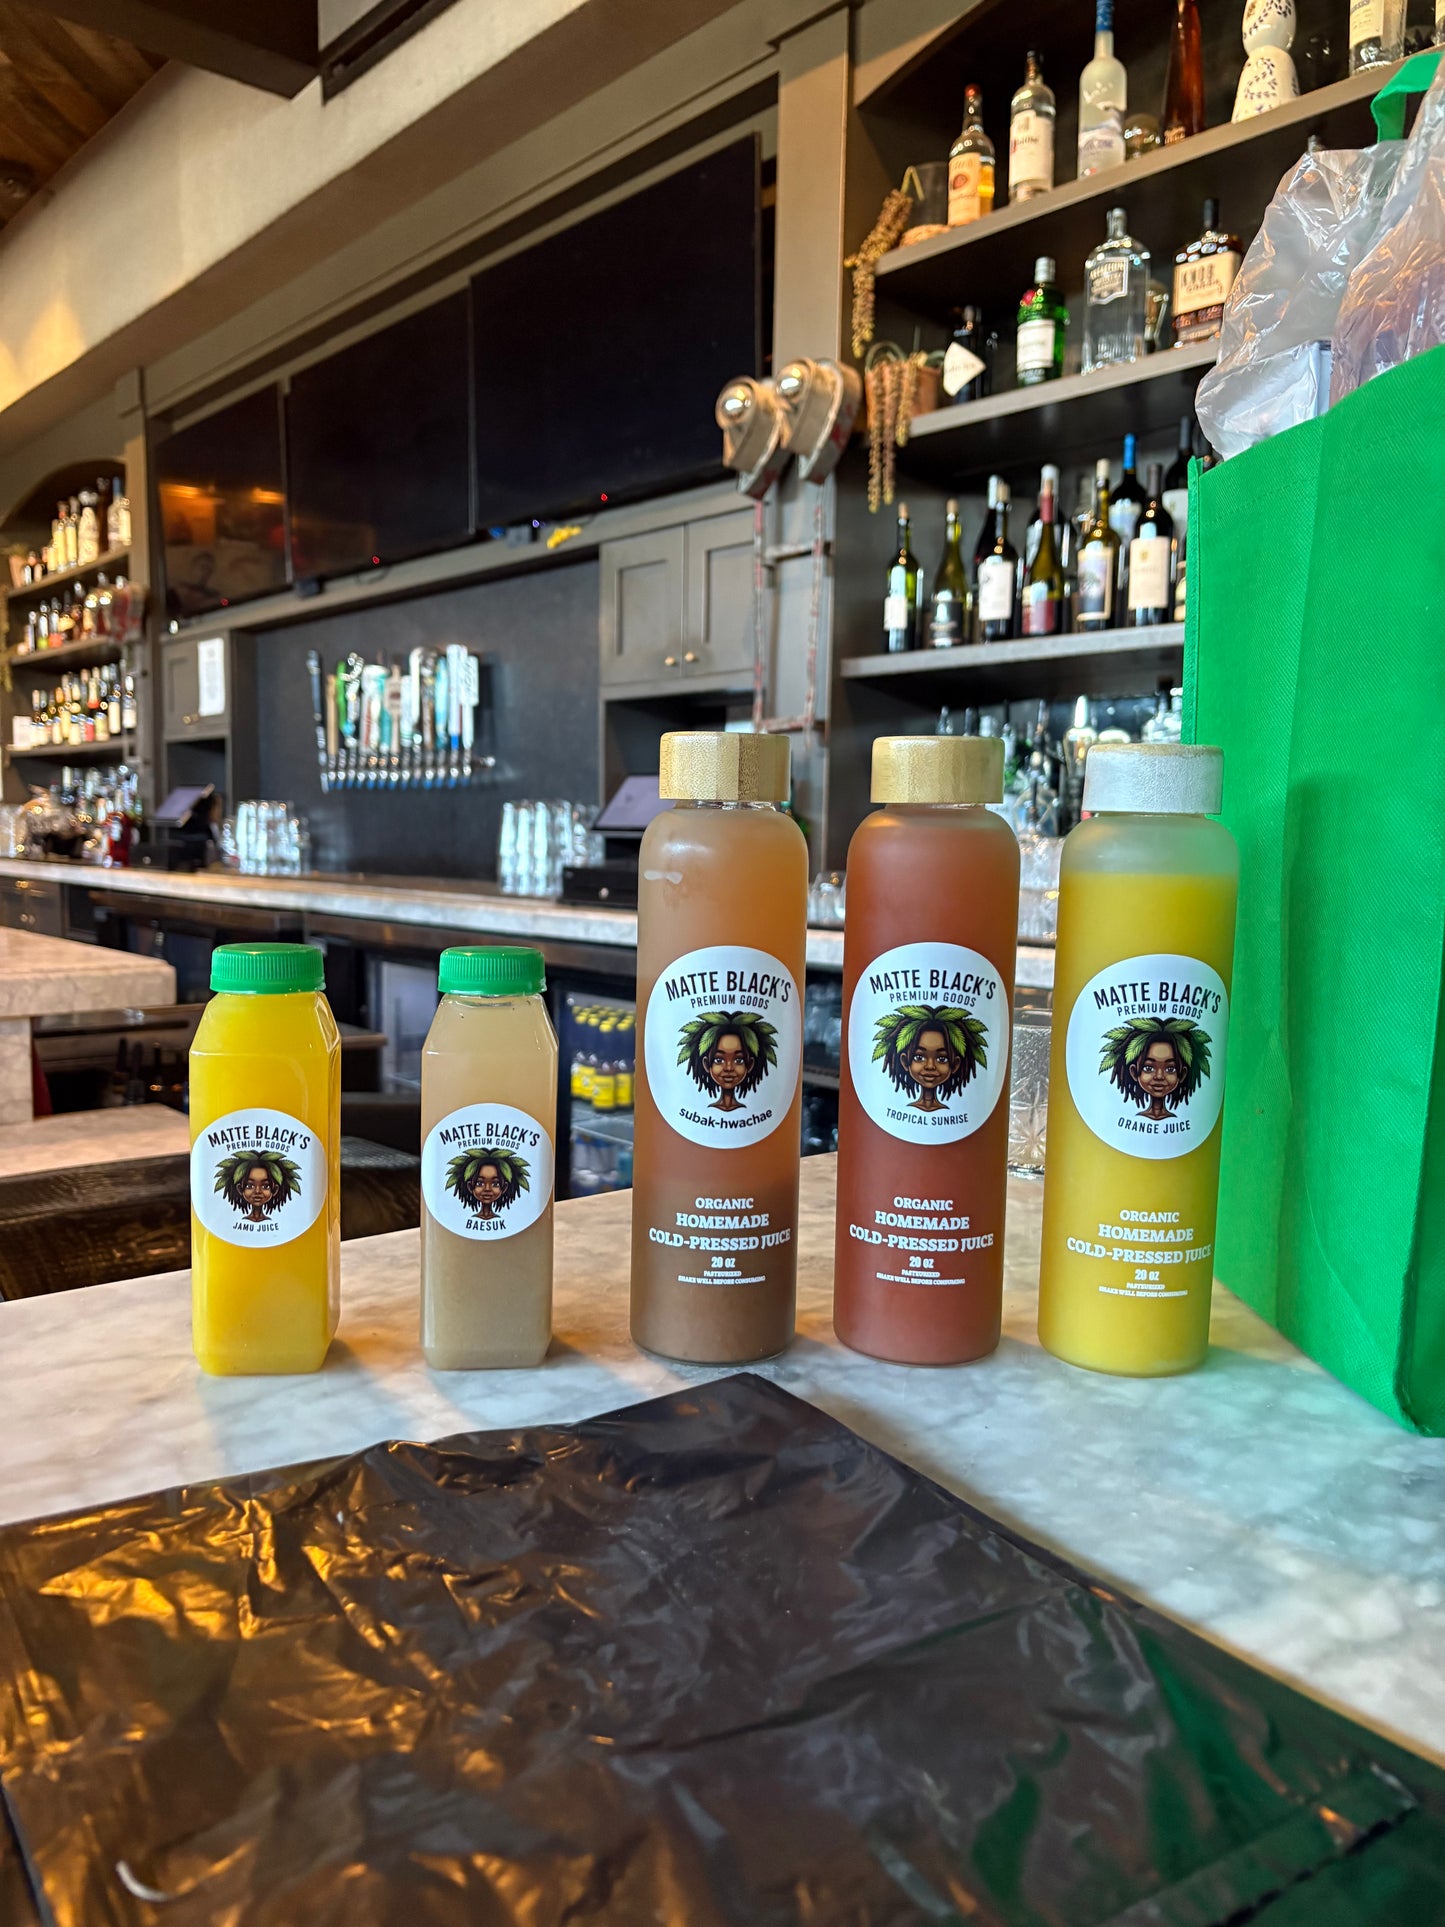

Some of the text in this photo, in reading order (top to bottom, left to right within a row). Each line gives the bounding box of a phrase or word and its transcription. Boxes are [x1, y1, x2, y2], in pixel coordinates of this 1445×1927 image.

[665, 971, 791, 1002] MATTE BLACK'S
[870, 969, 996, 999] MATTE BLACK'S
[691, 995, 769, 1009] PREMIUM GOODS
[890, 991, 976, 1007] PREMIUM GOODS
[1094, 982, 1221, 1014] MATTE BLACK'S
[1117, 1004, 1202, 1019] PREMIUM GOODS
[679, 1108, 772, 1128] subak-hwachae
[886, 1108, 968, 1126] TROPICAL SUNRISE
[1118, 1118, 1191, 1133] ORANGE JUICE
[208, 1126, 310, 1149] MATTE BLACK'S
[440, 1123, 540, 1146] MATTE BLACK'S
[226, 1141, 290, 1152] PREMIUM GOODS
[458, 1138, 520, 1149] PREMIUM GOODS
[695, 1198, 753, 1210] ORGANIC
[894, 1197, 953, 1211] ORGANIC
[676, 1212, 769, 1229] HOMEMADE
[875, 1211, 969, 1230] HOMEMADE
[1120, 1210, 1179, 1222] ORGANIC
[233, 1223, 279, 1232] JAMU JUICE
[466, 1220, 506, 1231] BAESUK
[1098, 1224, 1193, 1243] HOMEMADE
[649, 1228, 791, 1251] COLD-PRESSED JUICE
[850, 1224, 994, 1252] COLD-PRESSED JUICE
[1067, 1238, 1211, 1264] COLD-PRESSED JUICE
[711, 1256, 723, 1268] 20
[909, 1256, 921, 1268] 20
[1135, 1269, 1147, 1280] 20
